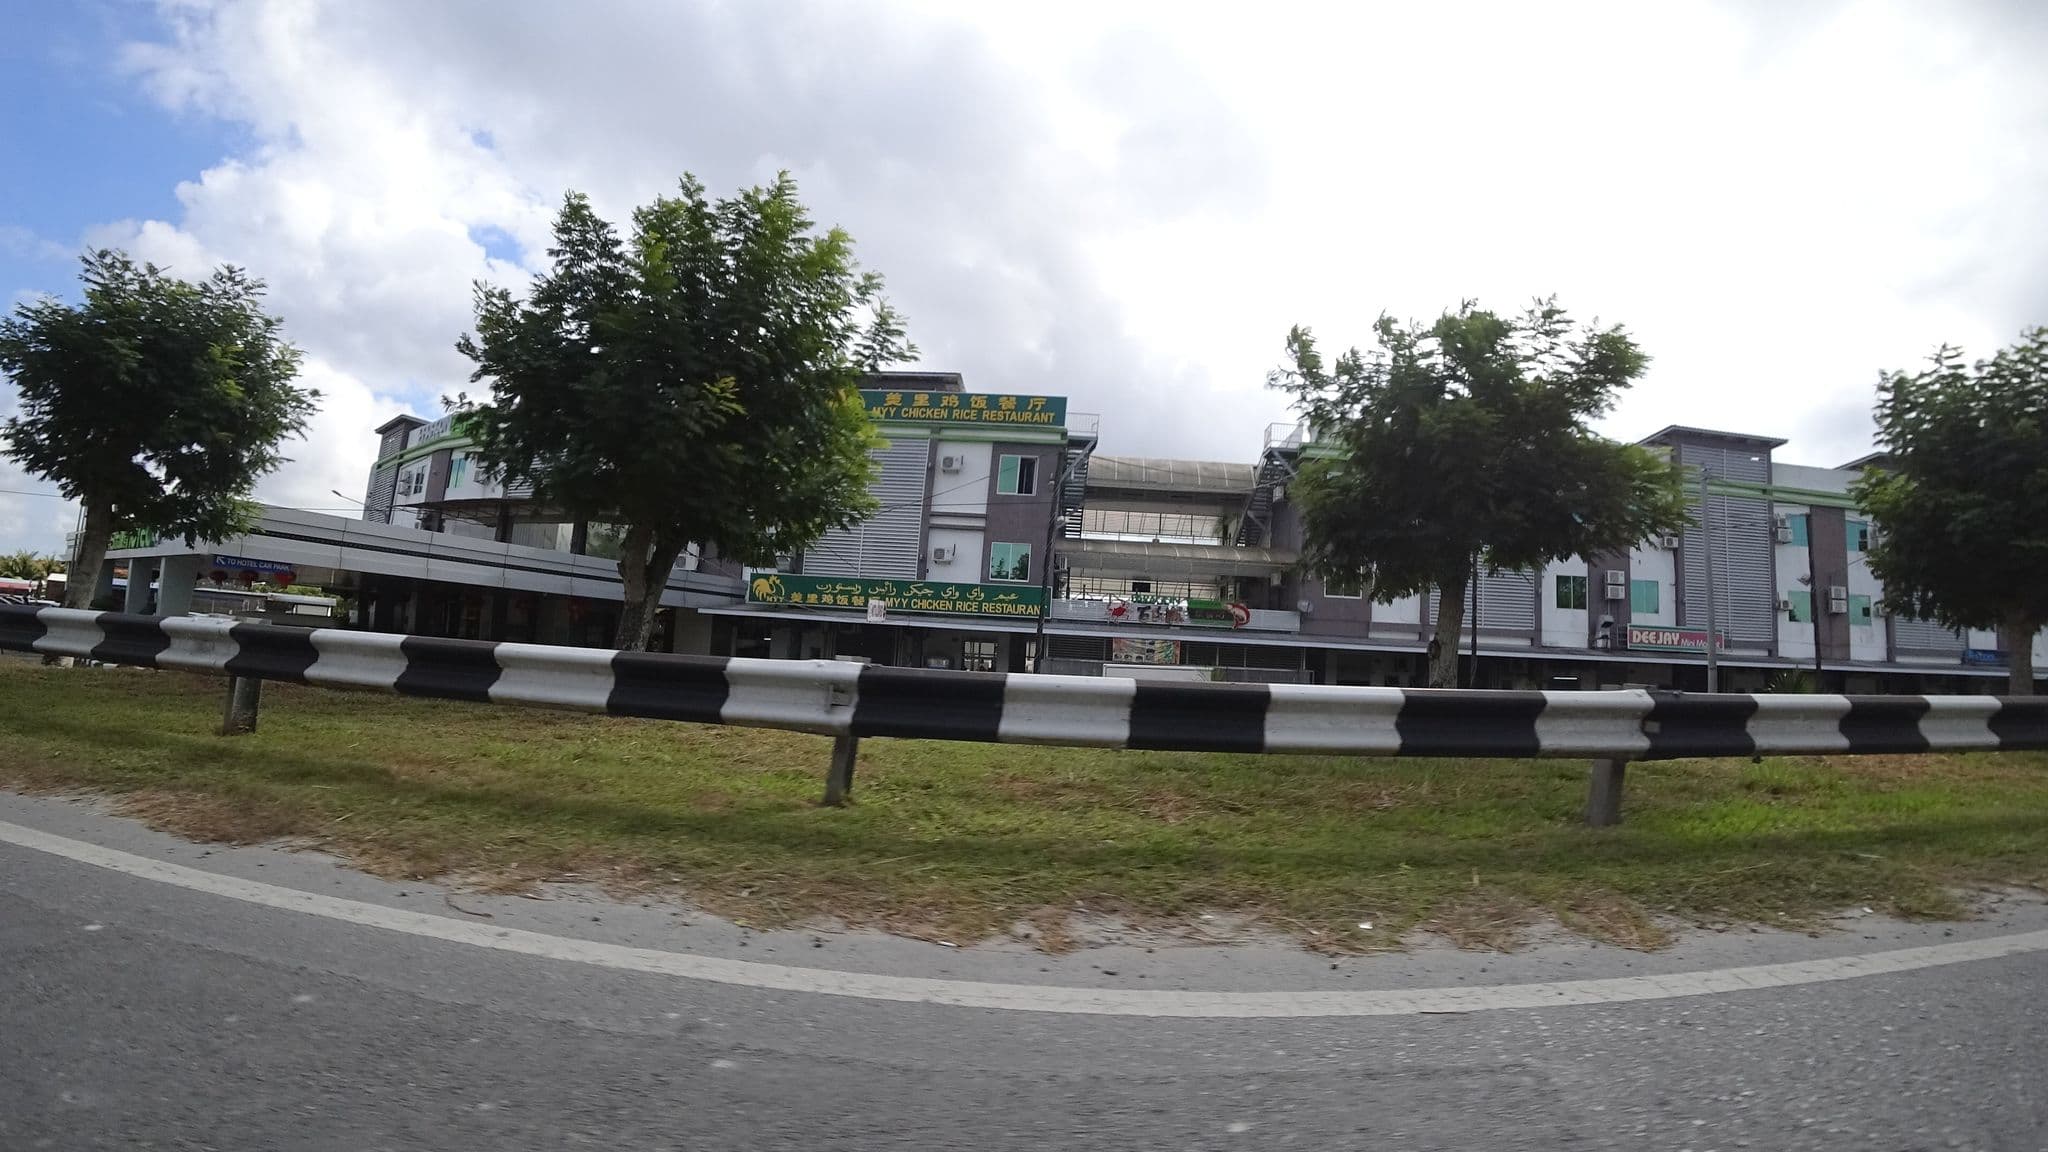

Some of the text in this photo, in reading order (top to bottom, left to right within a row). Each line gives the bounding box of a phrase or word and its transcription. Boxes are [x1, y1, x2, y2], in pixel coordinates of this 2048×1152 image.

[901, 408, 949, 420] CHICKEN
[954, 409, 978, 421] RICE
[982, 410, 1056, 423] RESTAURANT
[884, 597, 1044, 616] MYY CHICKEN RICE RESTAURAN
[1632, 630, 1680, 646] DEEJAY
